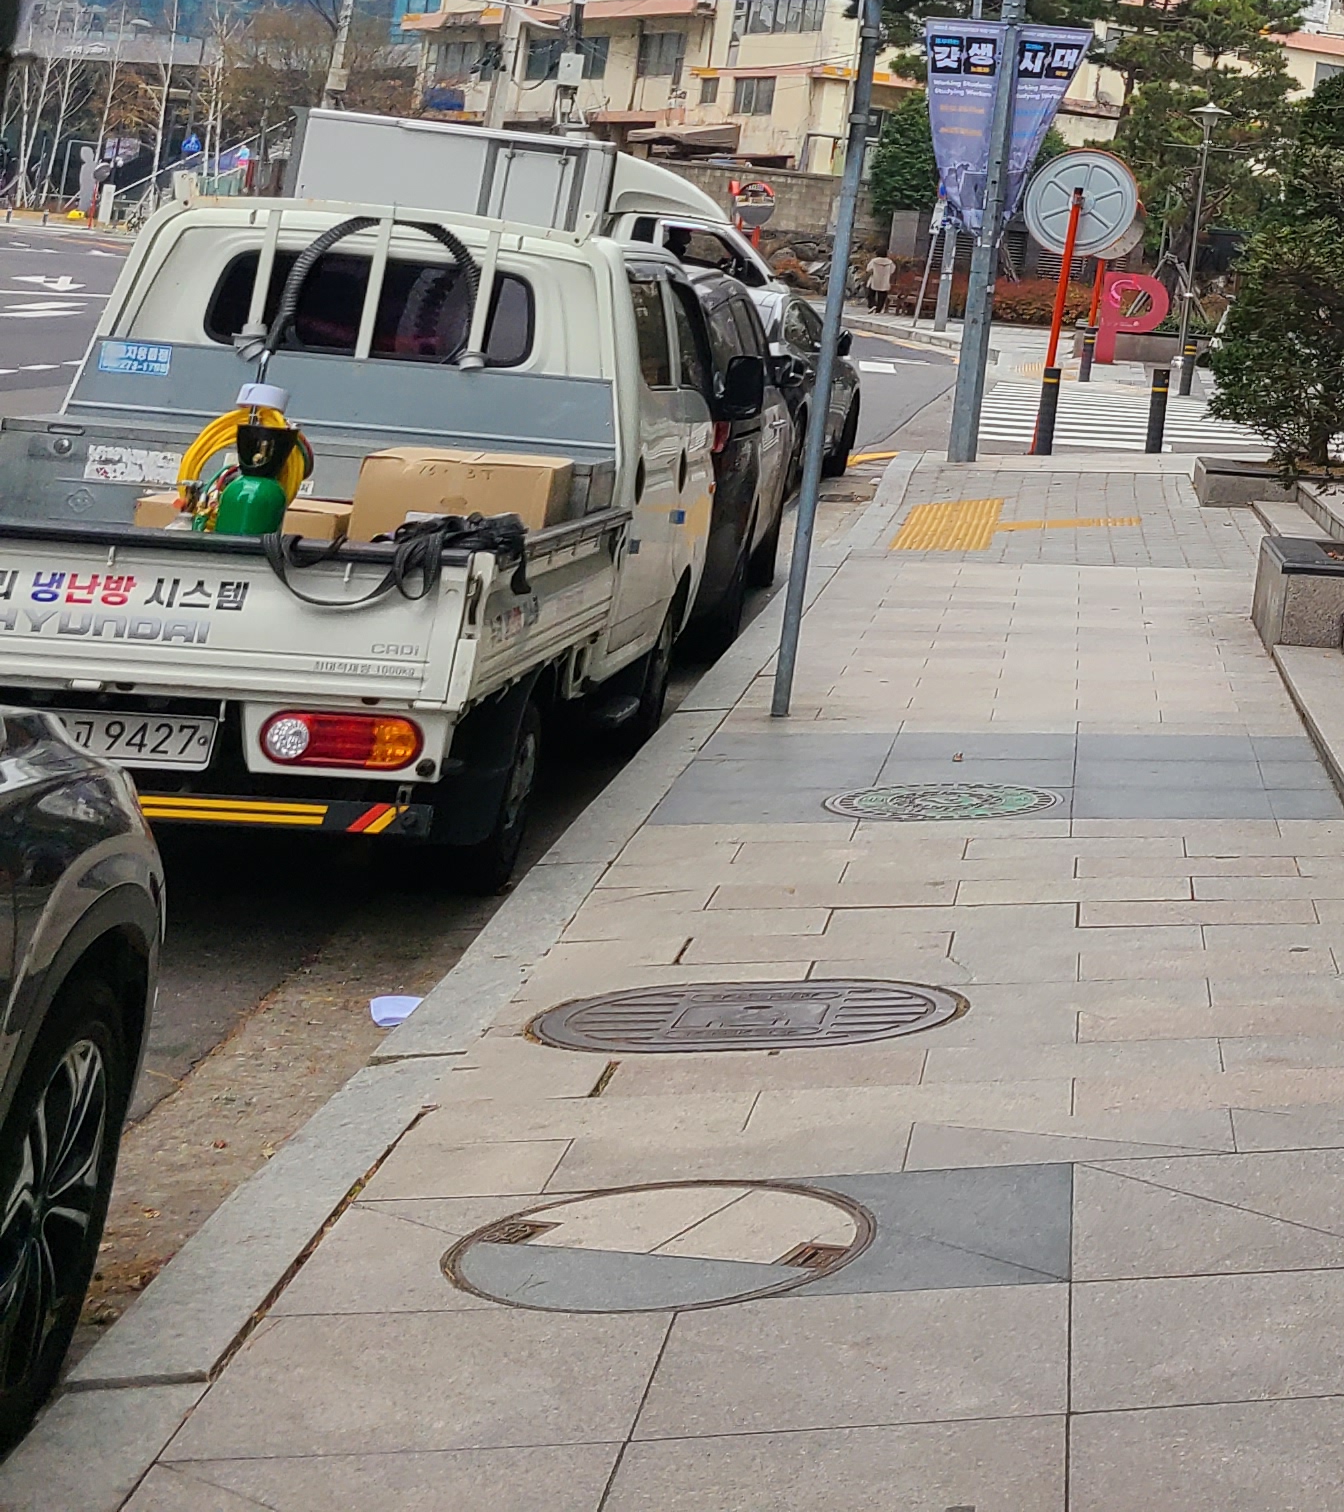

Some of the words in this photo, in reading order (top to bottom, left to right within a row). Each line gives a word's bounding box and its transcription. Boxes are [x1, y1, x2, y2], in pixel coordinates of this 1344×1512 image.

[31, 571, 138, 607] 냉난방
[143, 577, 250, 611] 시스템
[104, 719, 201, 756] 9427
